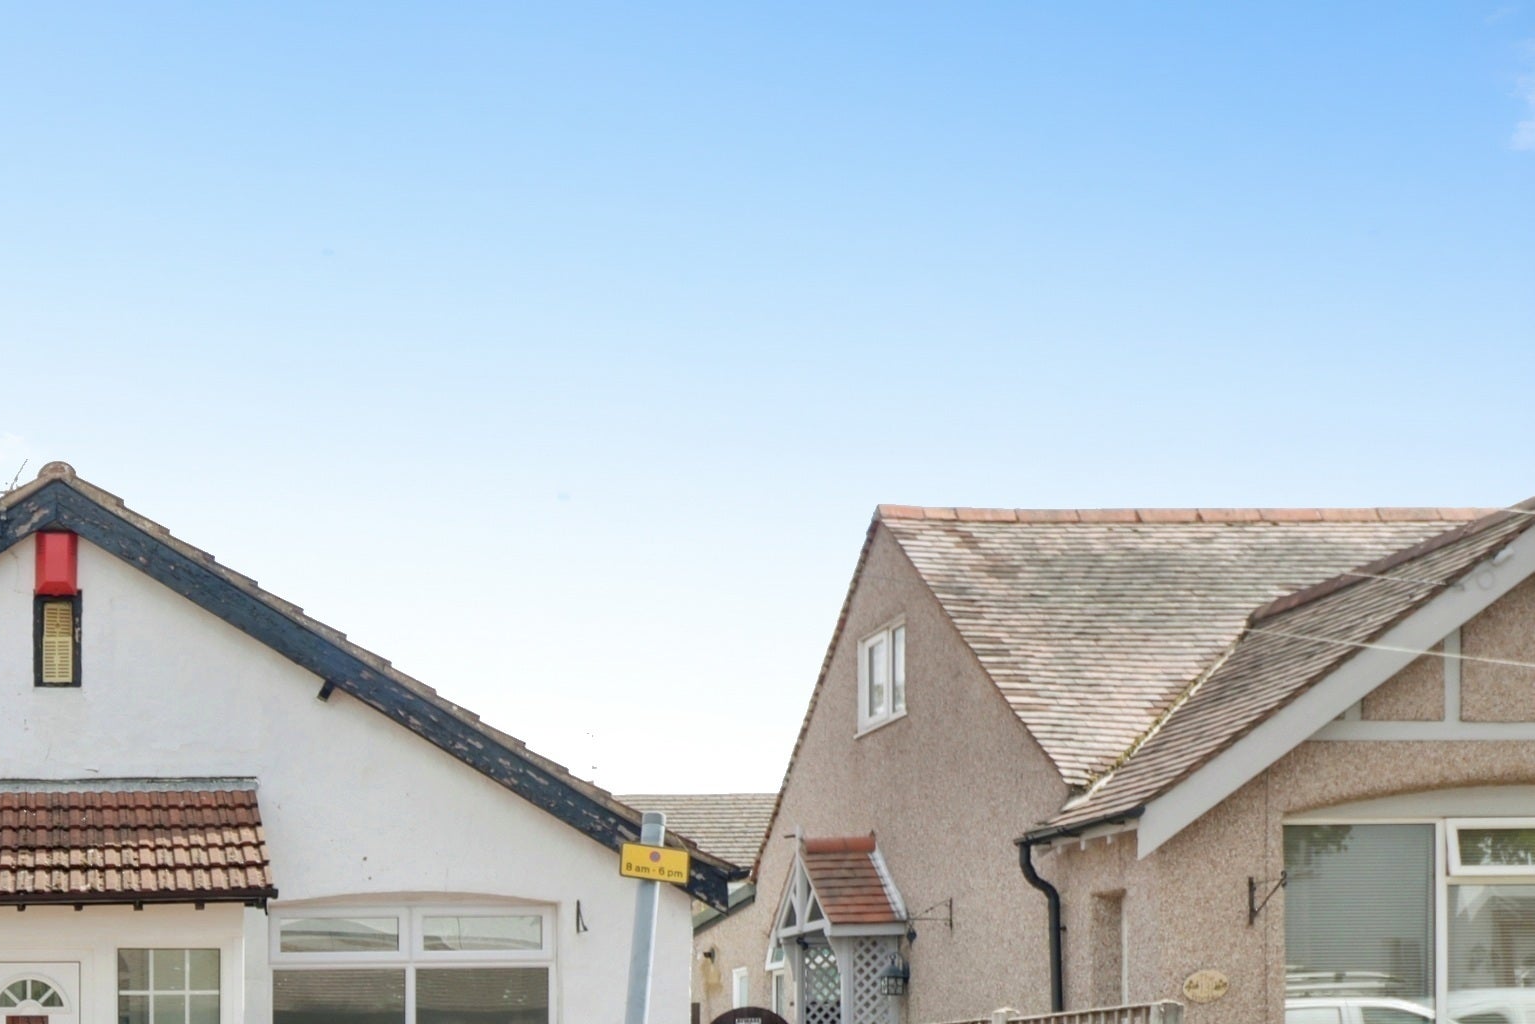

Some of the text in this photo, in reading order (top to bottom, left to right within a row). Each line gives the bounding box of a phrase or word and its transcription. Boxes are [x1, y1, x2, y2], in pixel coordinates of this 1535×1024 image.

[625, 862, 633, 872] 8
[634, 865, 650, 874] am
[658, 867, 665, 876] 6
[667, 869, 683, 878] pm
